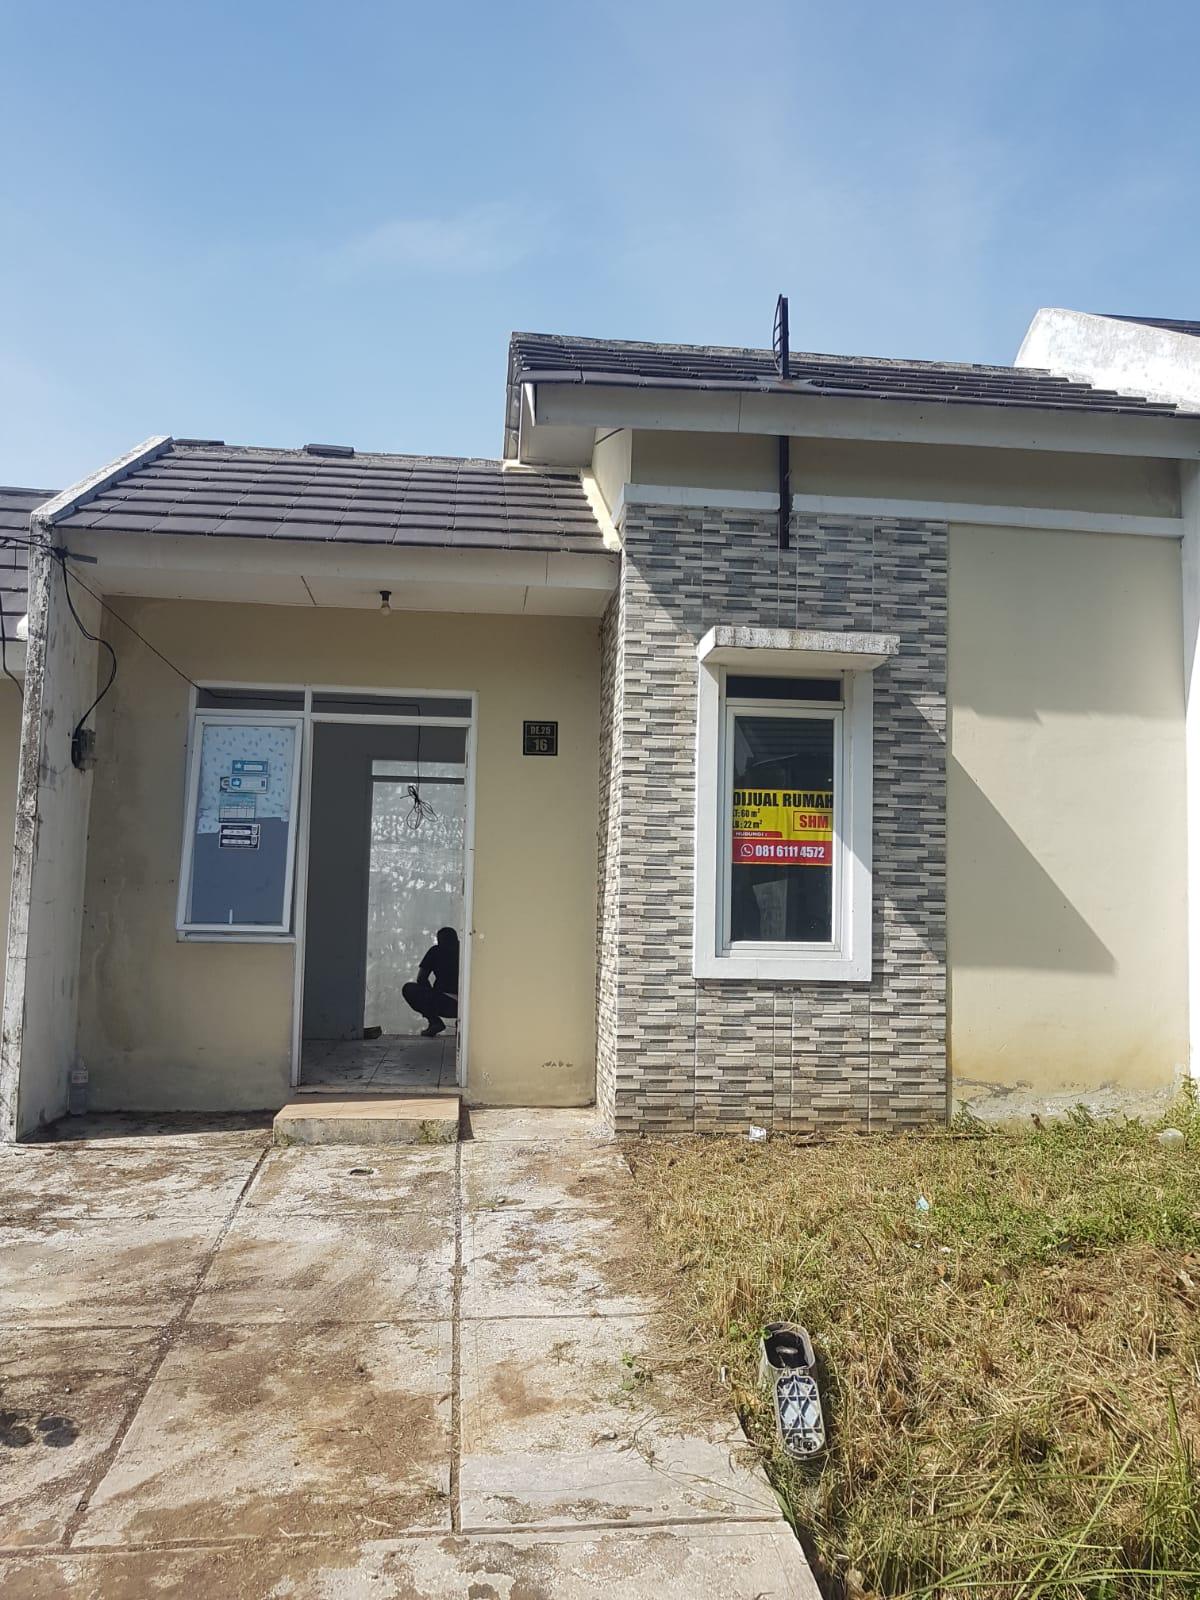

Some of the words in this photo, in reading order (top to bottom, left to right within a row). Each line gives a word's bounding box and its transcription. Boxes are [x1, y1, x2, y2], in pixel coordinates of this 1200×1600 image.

[533, 738, 548, 751] 16
[733, 791, 779, 807] DIJUAL
[782, 793, 833, 808] RUMAH
[743, 820, 752, 829] 22
[799, 814, 829, 829] SHM
[755, 844, 775, 857] 081
[776, 845, 798, 857] 6111
[800, 846, 824, 858] 4572
